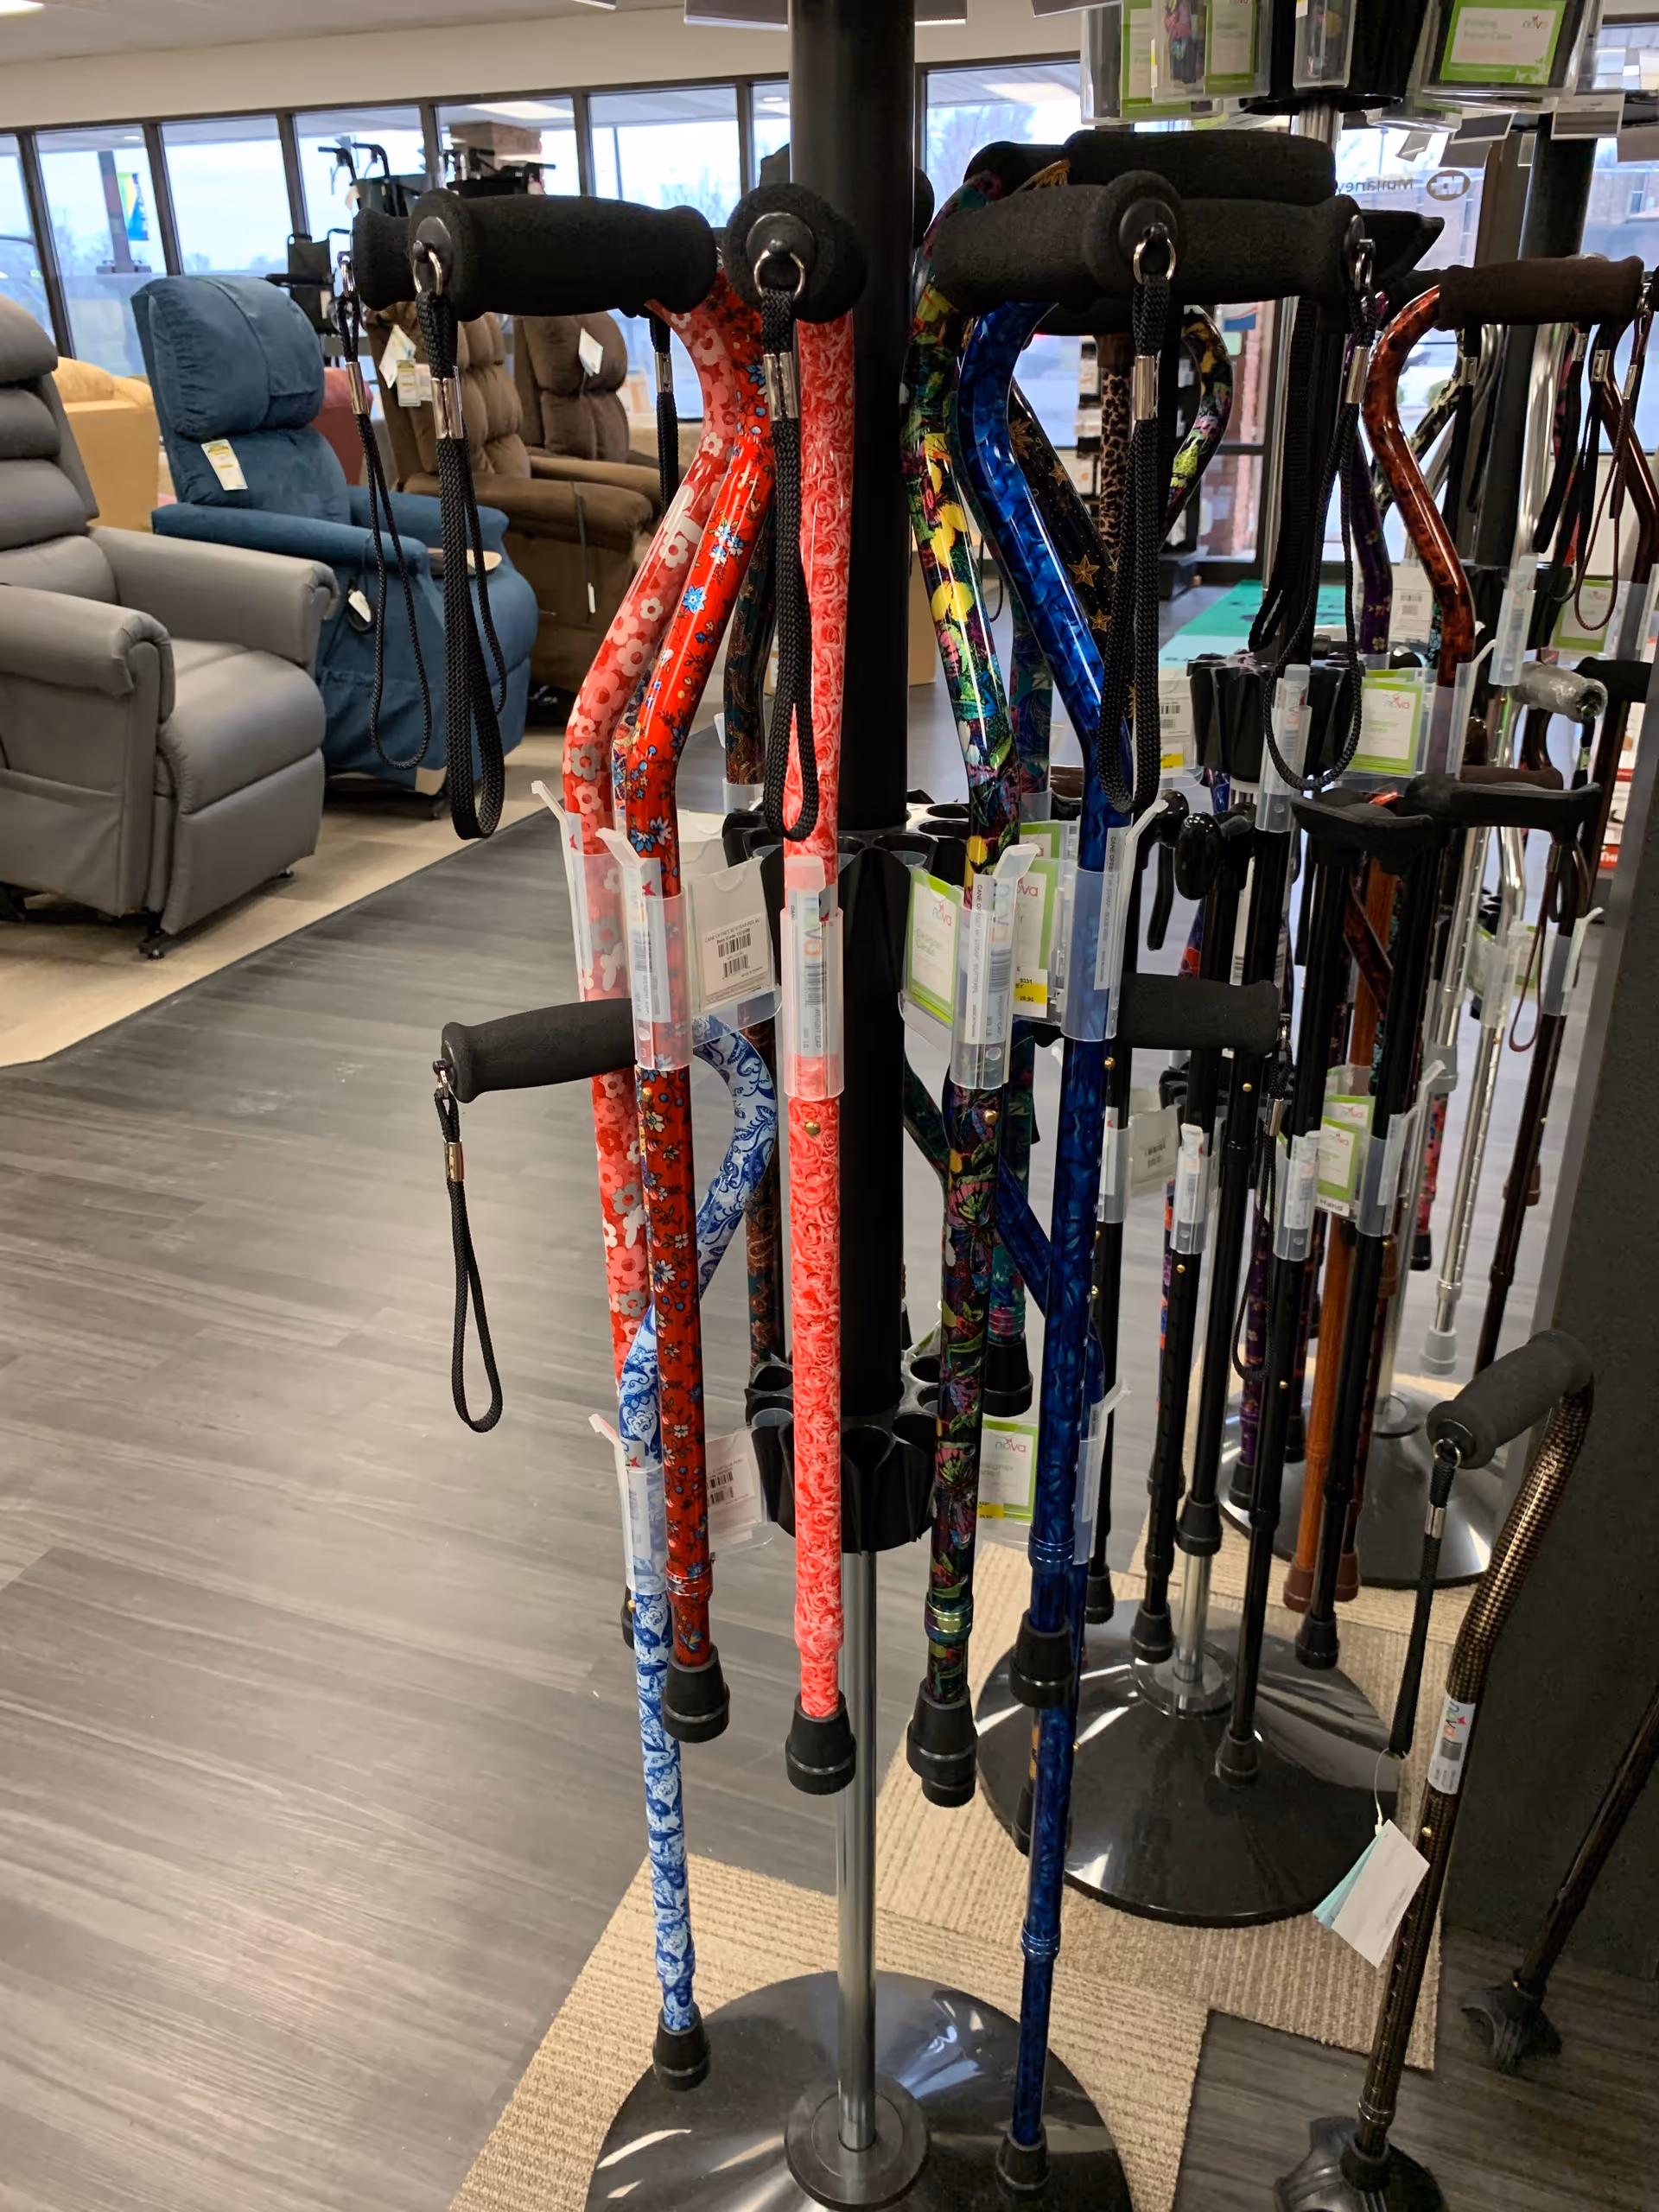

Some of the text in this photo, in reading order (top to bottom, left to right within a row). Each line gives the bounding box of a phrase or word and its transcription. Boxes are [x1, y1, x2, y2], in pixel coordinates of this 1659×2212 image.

[1521, 19, 1548, 30] nova
[932, 906, 952, 926] nova
[995, 1440, 1027, 1452] nova
[1443, 1700, 1459, 1738] nova
